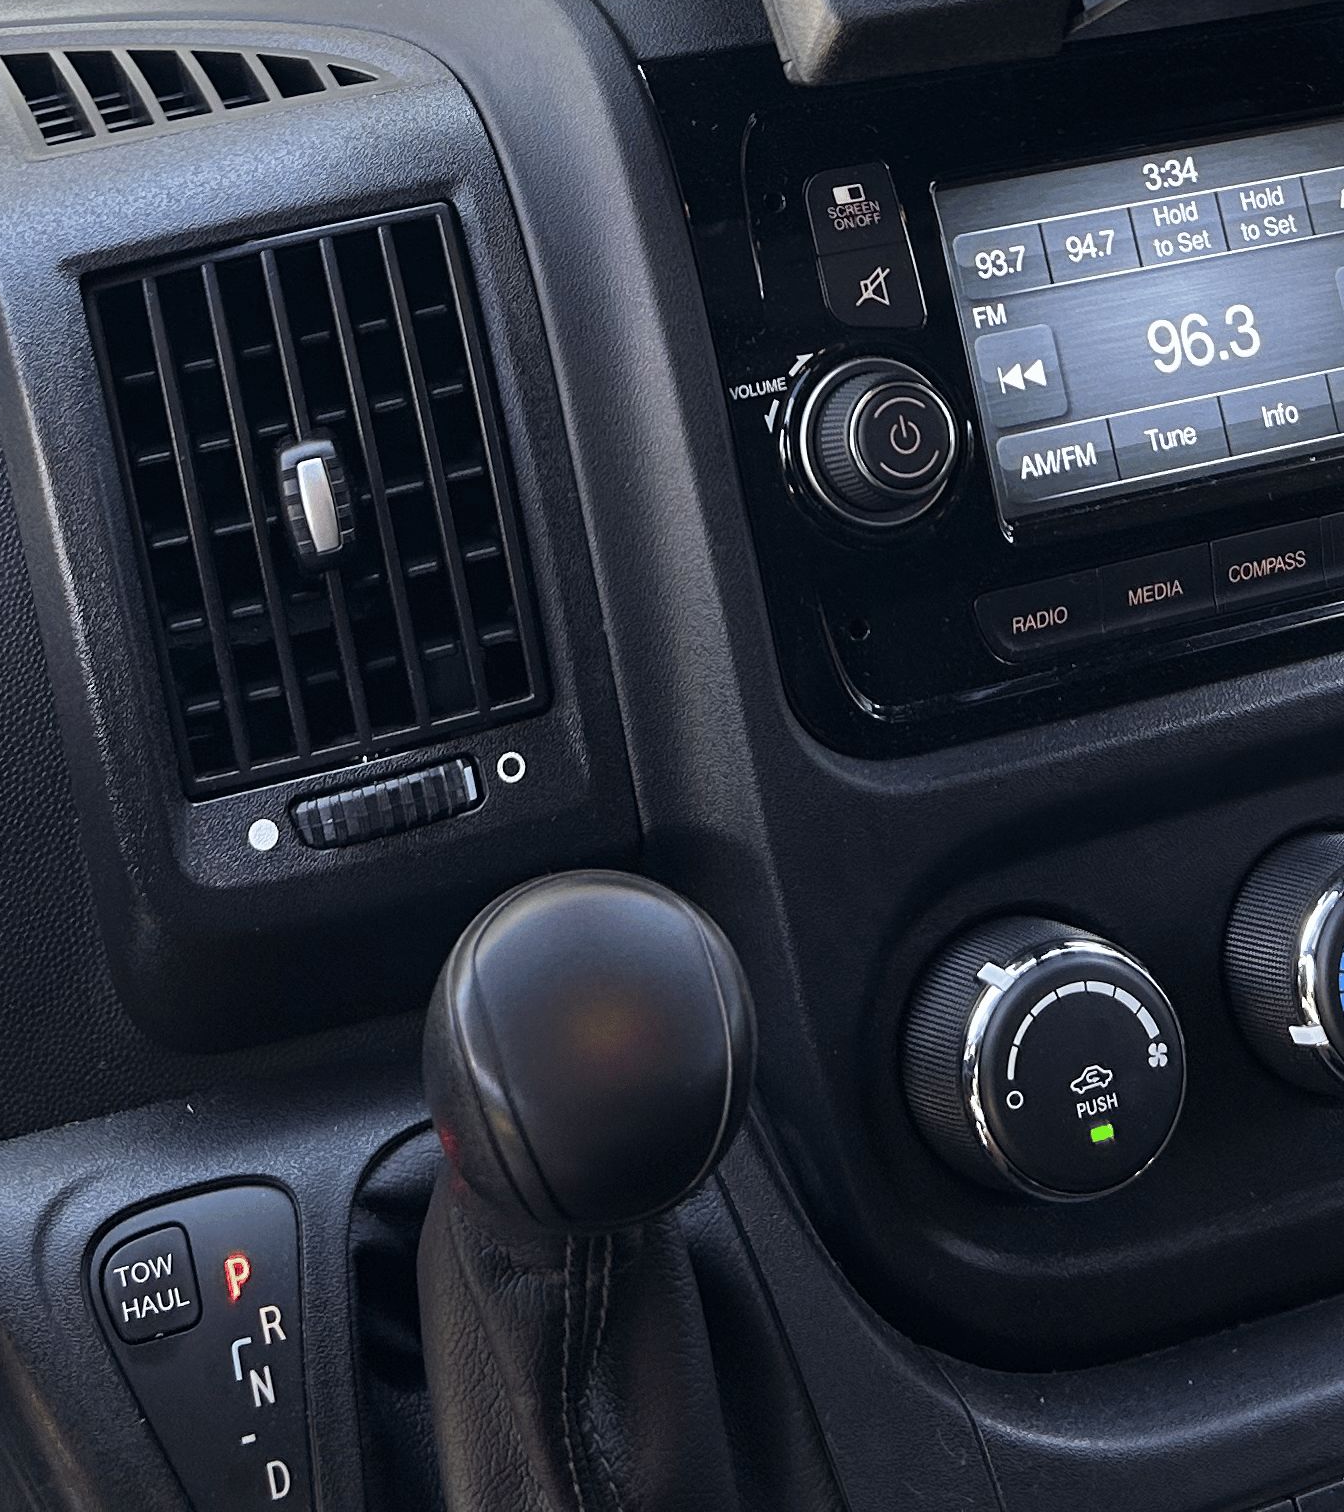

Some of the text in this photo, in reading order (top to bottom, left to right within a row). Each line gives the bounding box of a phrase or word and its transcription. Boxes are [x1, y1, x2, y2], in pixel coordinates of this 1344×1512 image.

[1142, 156, 1199, 191] 3:34
[827, 200, 880, 219] SCREEN
[1152, 200, 1199, 227] Hold
[1239, 185, 1285, 211] Hold
[1153, 229, 1212, 258] to Set
[1240, 214, 1298, 241] to Set
[1065, 229, 1115, 263] 94.7
[974, 245, 1025, 280] 93.7
[972, 303, 1007, 329] FM
[1147, 304, 1261, 373] 96.3
[729, 376, 788, 401] VOLUME
[1261, 405, 1299, 429] Info
[1144, 425, 1198, 453] Tune
[1020, 442, 1097, 480] AM/FM
[1227, 550, 1306, 584] COMPASS
[1127, 579, 1184, 608] MEDIA
[1012, 605, 1069, 636] RADIO
[1076, 1092, 1119, 1119] PUSH
[113, 1253, 173, 1288] TOW
[224, 1251, 252, 1301] P
[122, 1288, 191, 1323] HAUL
[259, 1305, 287, 1345] R
[249, 1365, 276, 1408] N
[266, 1460, 291, 1501] D
